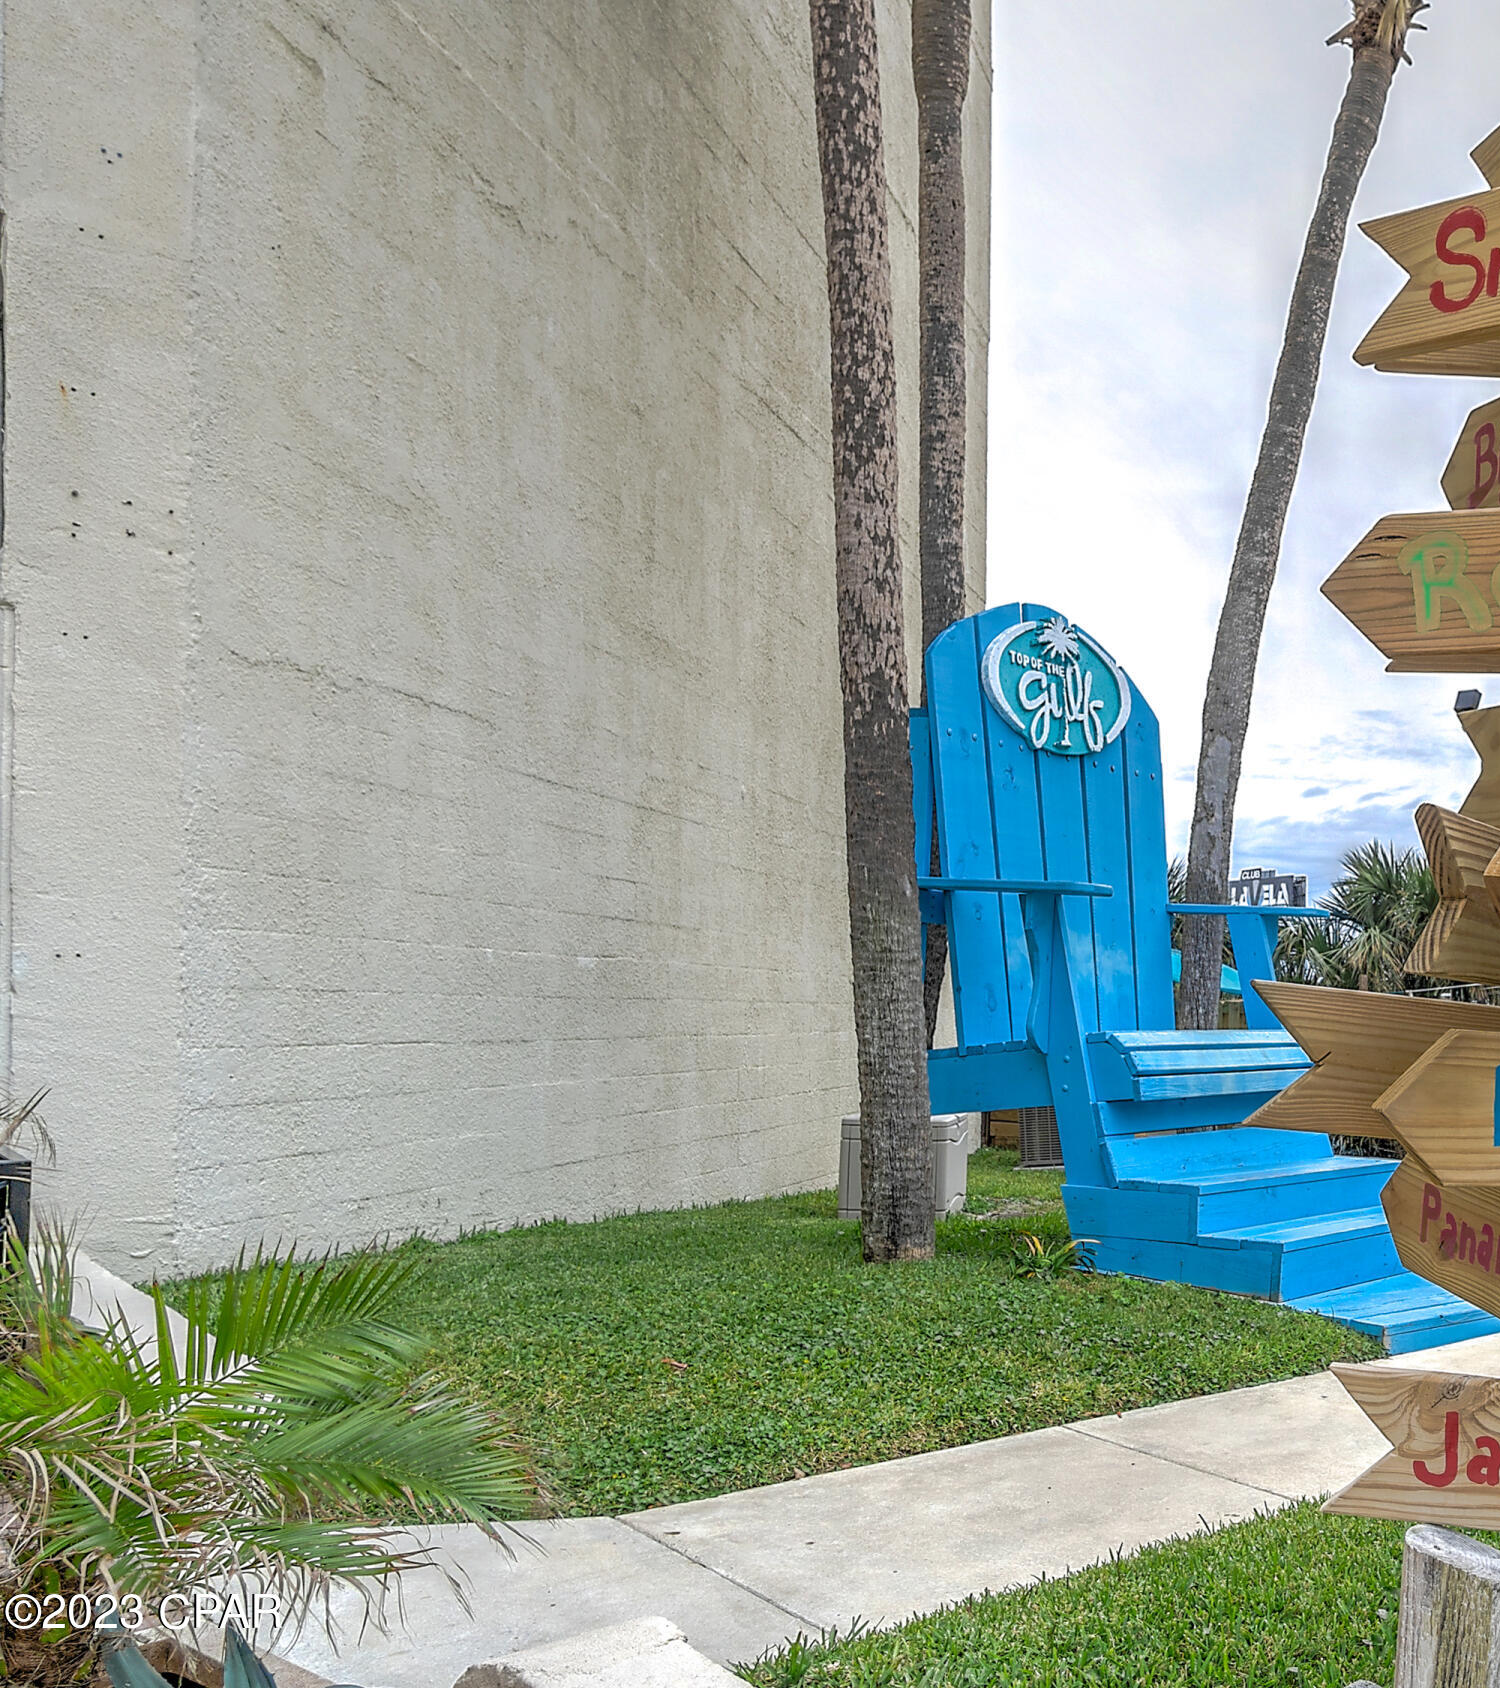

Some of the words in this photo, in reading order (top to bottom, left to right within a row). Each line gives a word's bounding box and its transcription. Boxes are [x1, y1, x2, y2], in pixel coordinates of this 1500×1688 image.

[1009, 650, 1029, 668] TOP
[1031, 658, 1043, 670] OF
[1045, 662, 1066, 678] THE
[1241, 870, 1260, 880] CLUB
